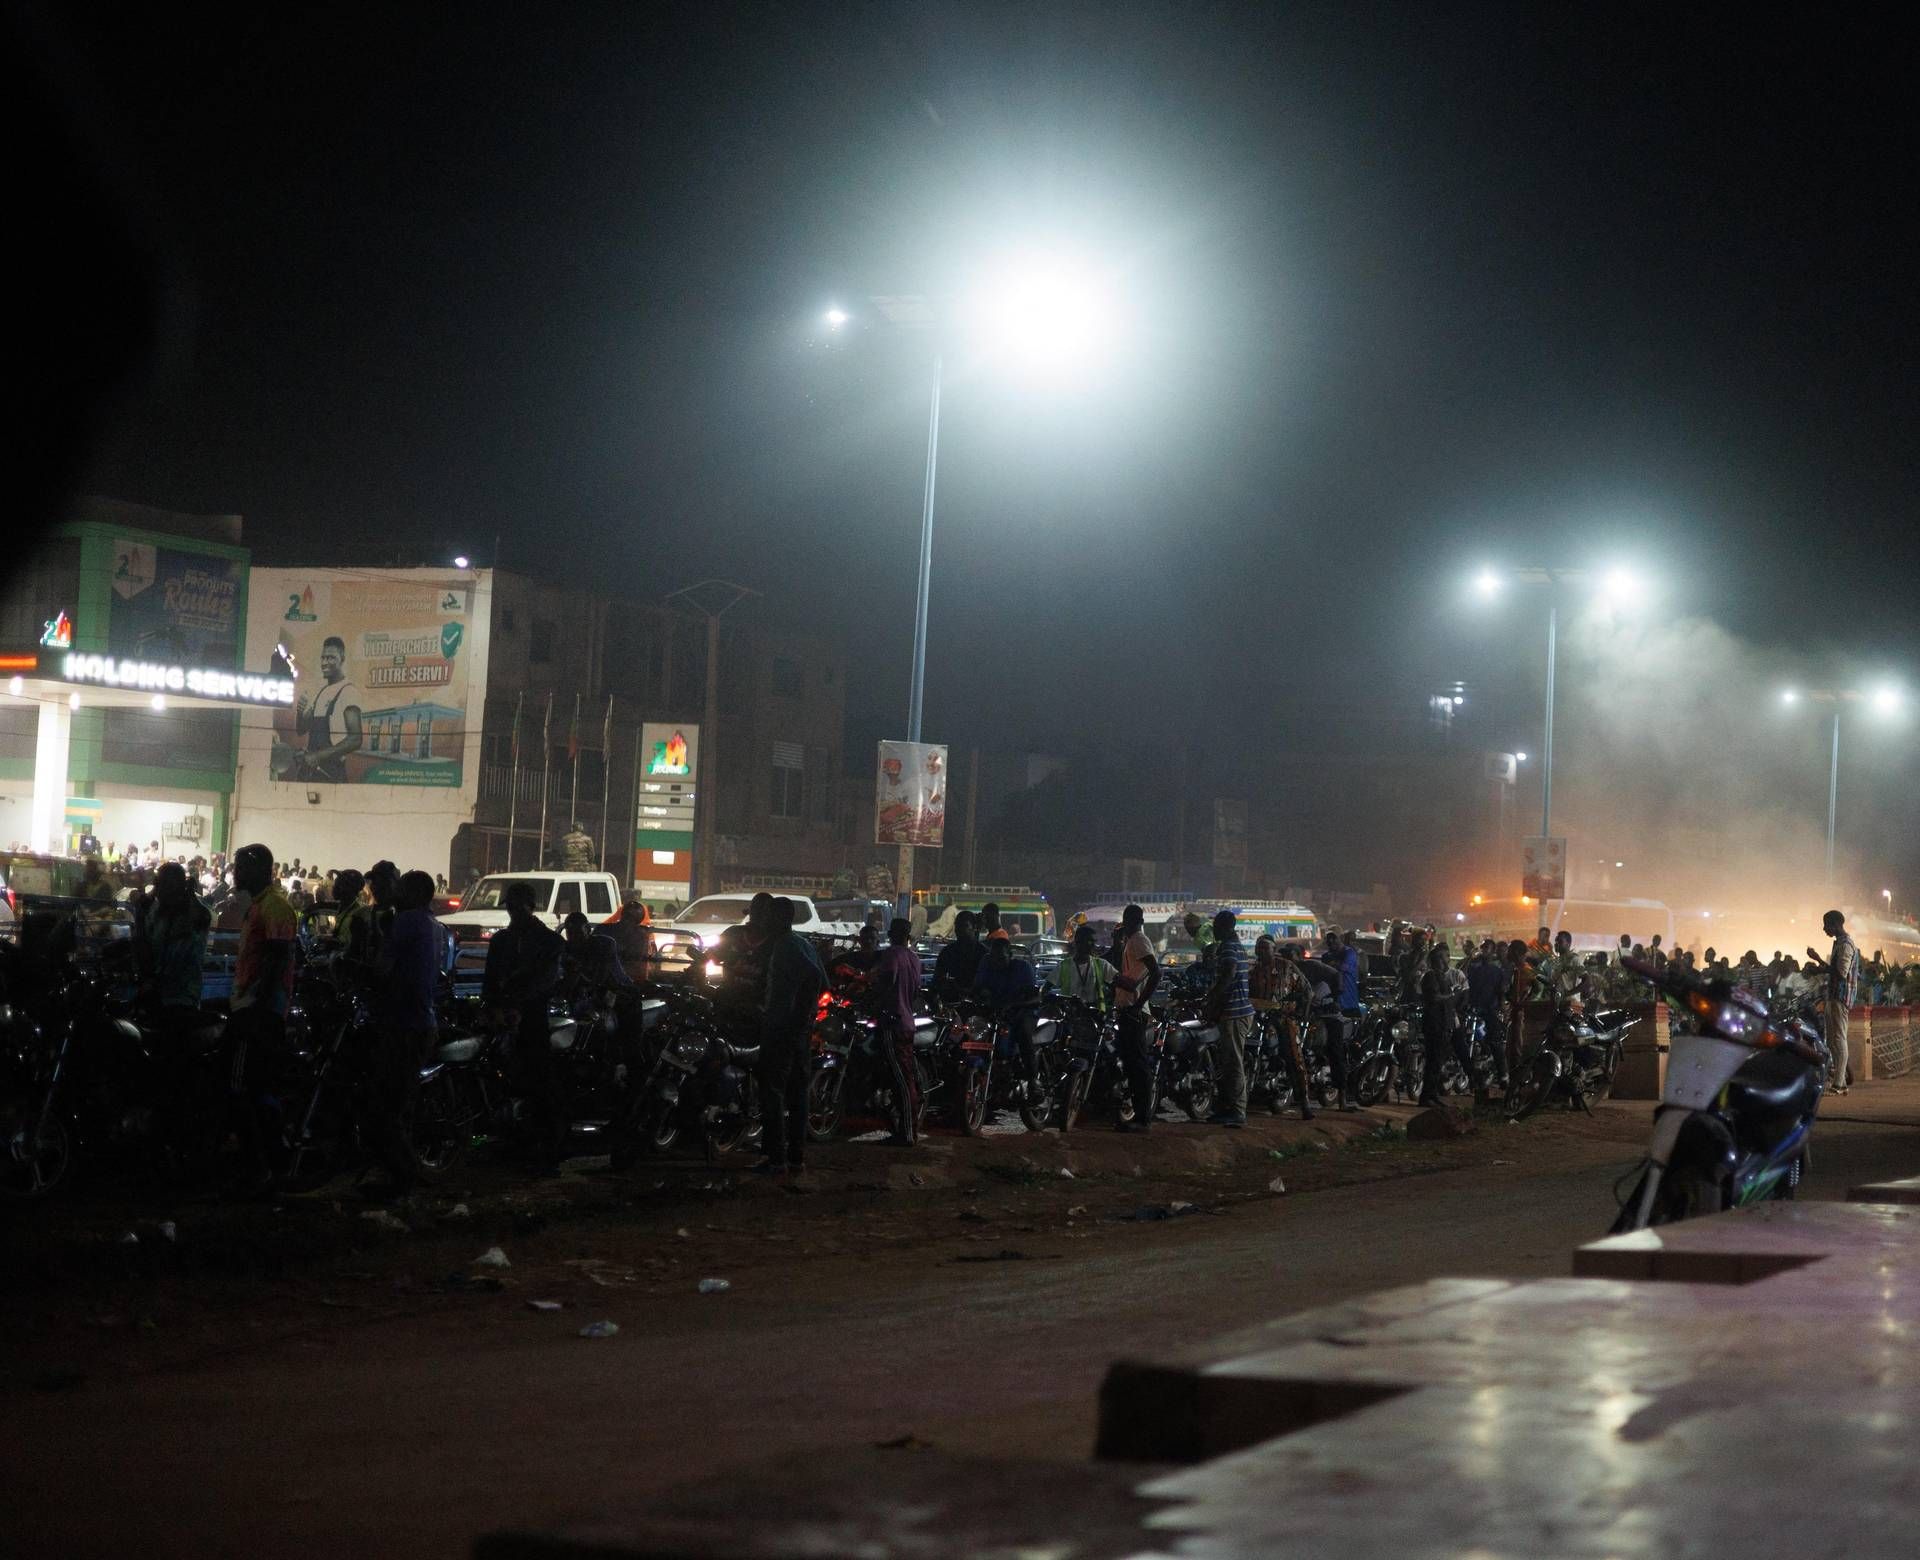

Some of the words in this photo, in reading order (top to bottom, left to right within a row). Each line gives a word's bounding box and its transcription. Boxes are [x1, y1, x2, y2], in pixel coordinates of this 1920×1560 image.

[65, 652, 184, 690] HOLDING
[186, 668, 295, 703] SERVICE
[378, 666, 408, 684] LITRE
[409, 665, 442, 682] SERVI
